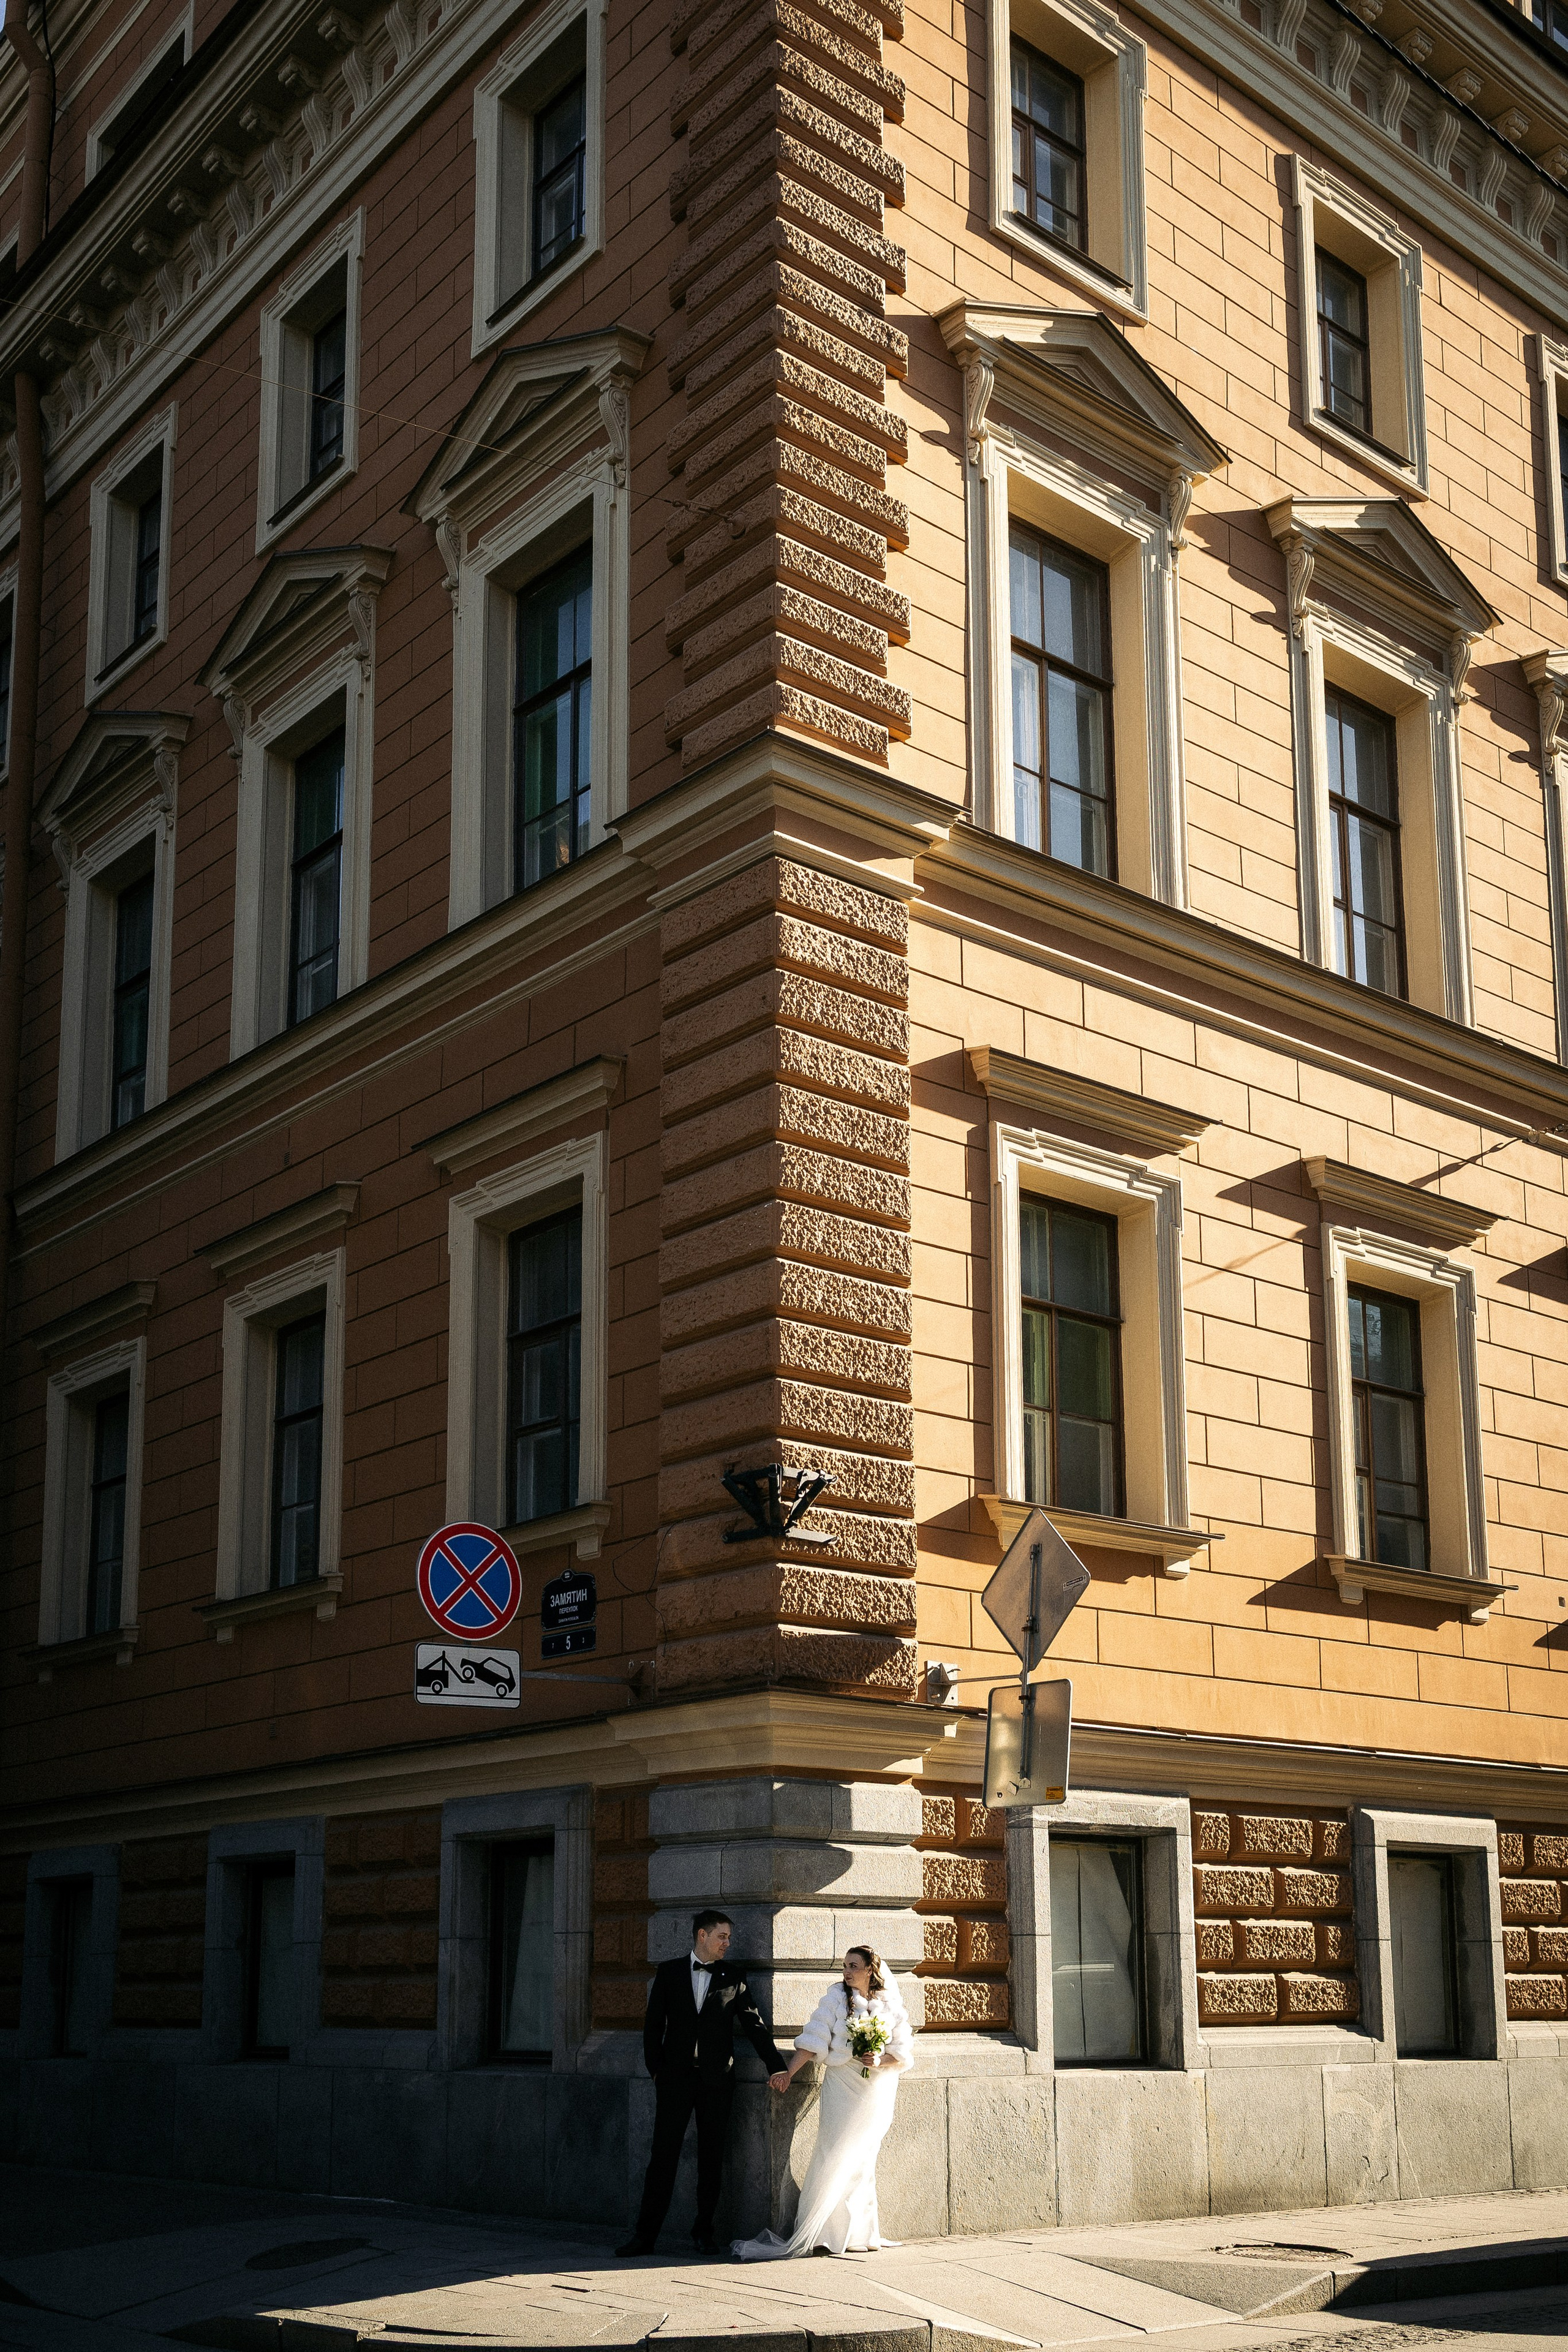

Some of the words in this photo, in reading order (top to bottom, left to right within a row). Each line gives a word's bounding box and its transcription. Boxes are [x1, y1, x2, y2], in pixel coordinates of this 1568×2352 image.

[550, 1588, 587, 1607] ЗАМЯТИН
[559, 1605, 578, 1614] ПЕРЕУЛОК
[566, 1635, 570, 1650] 5
